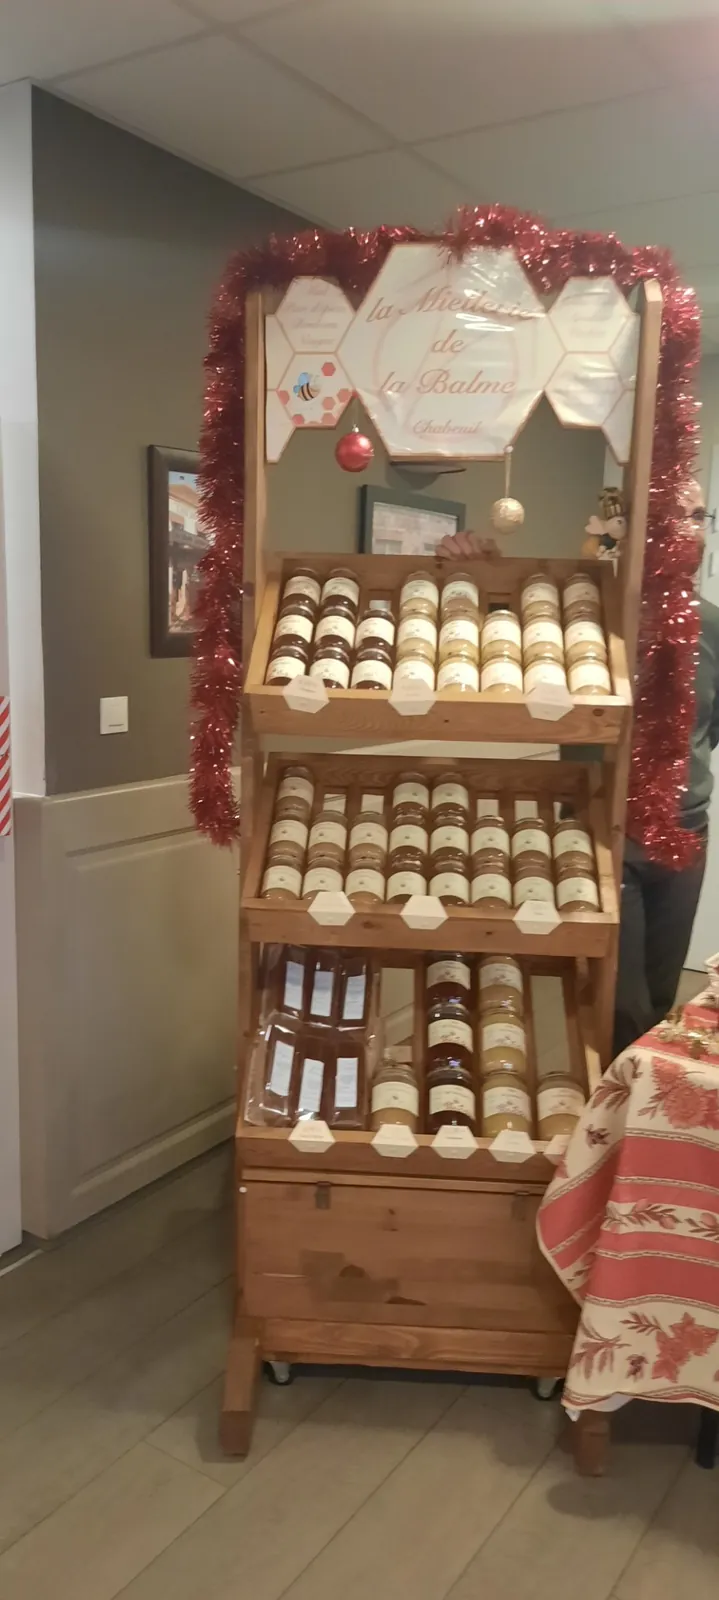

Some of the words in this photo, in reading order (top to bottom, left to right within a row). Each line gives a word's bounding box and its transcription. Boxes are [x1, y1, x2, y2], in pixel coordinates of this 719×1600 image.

[365, 296, 394, 322] la
[431, 328, 464, 353] de
[380, 370, 406, 394] la
[416, 368, 516, 394] Balme
